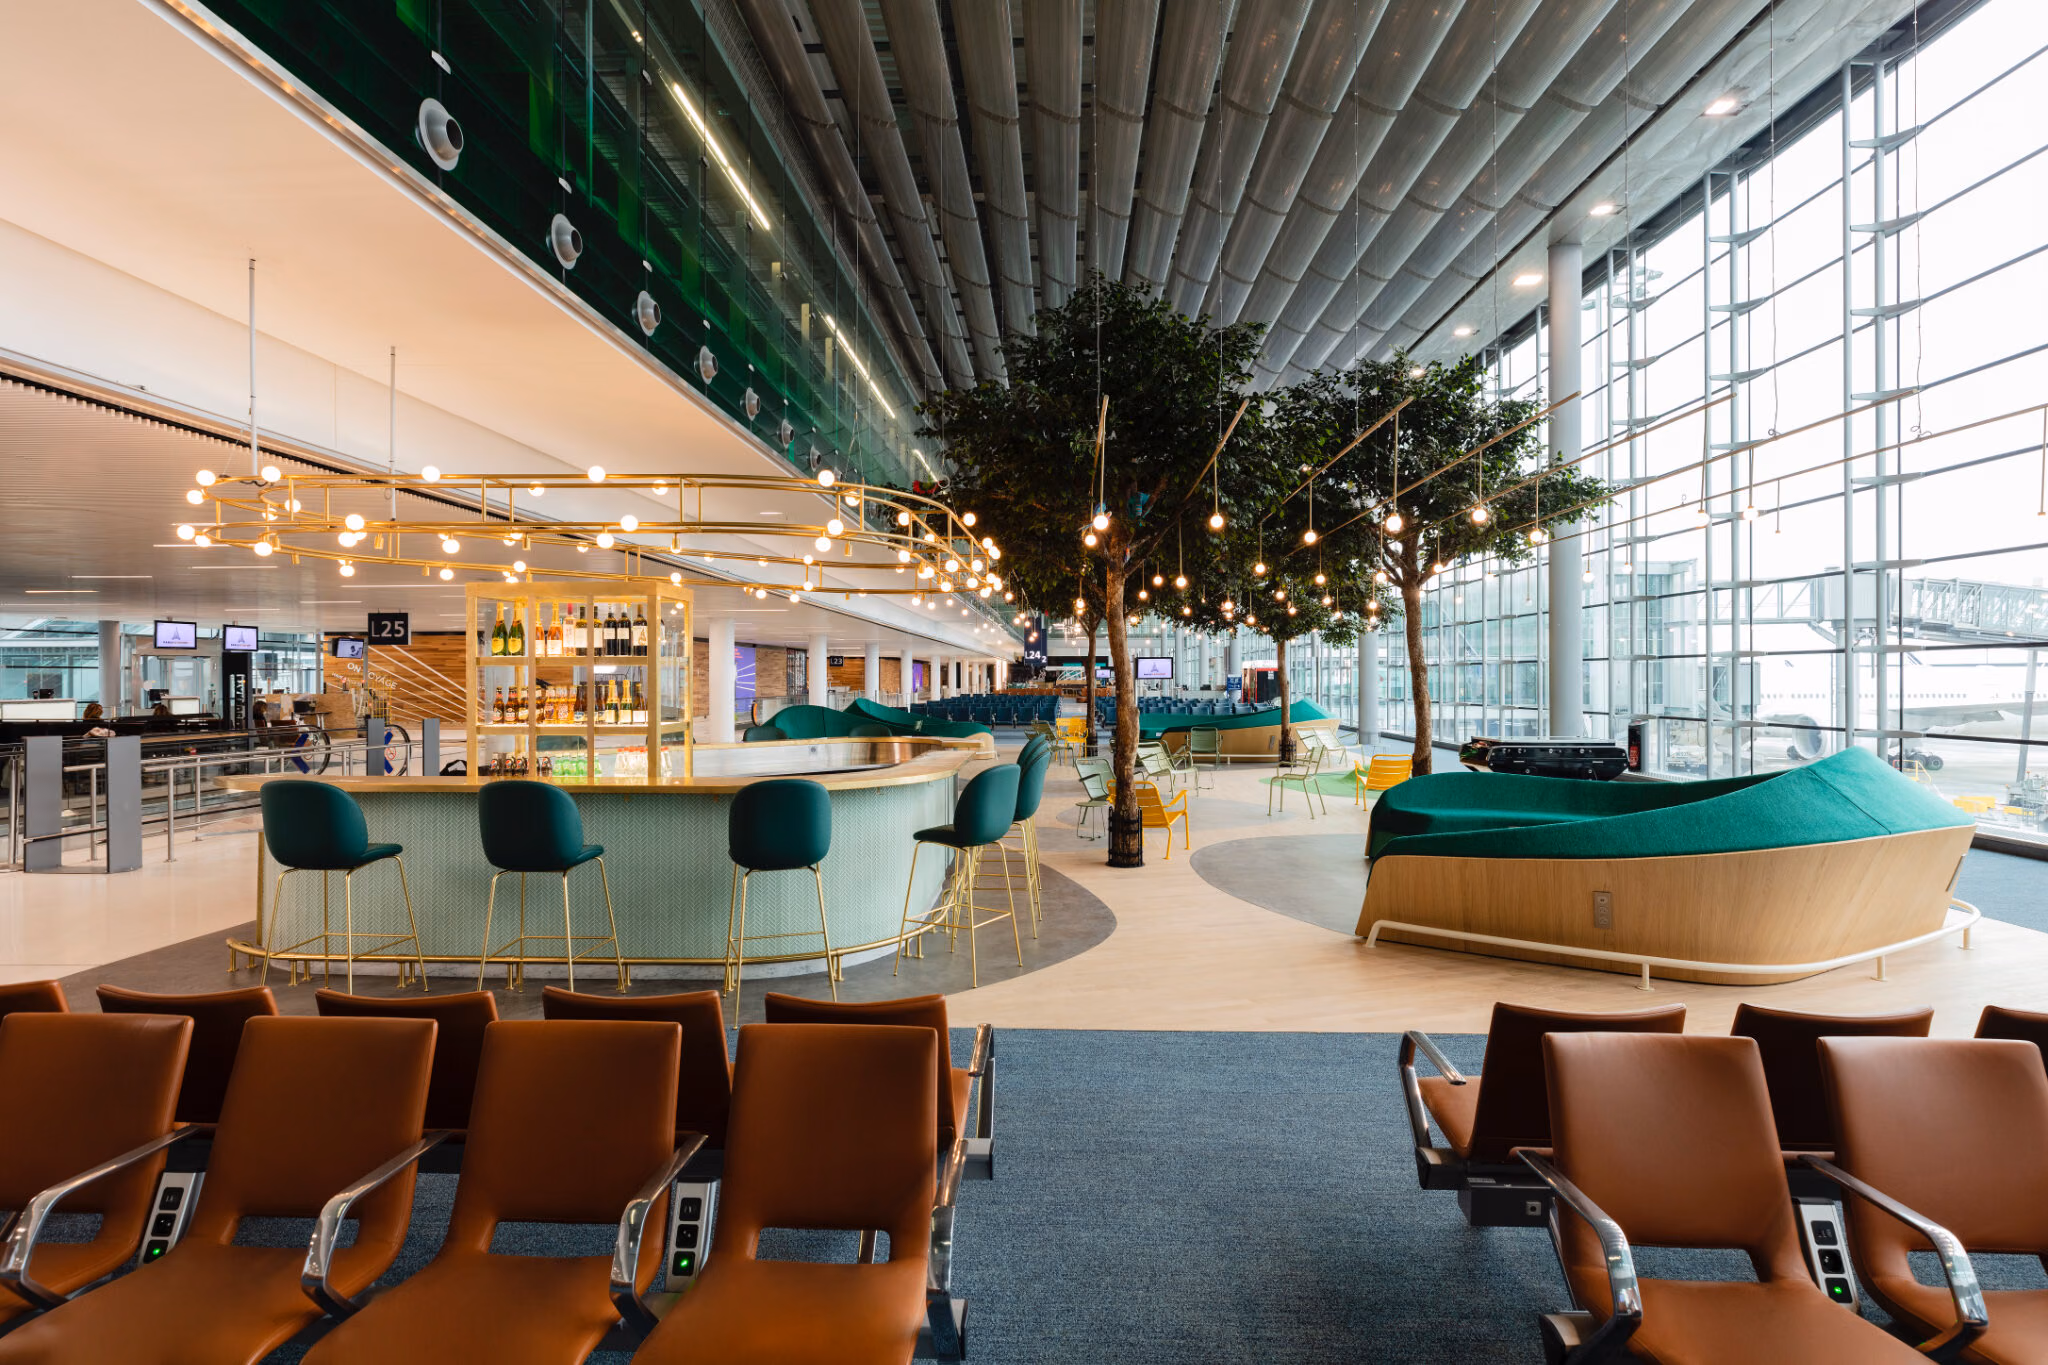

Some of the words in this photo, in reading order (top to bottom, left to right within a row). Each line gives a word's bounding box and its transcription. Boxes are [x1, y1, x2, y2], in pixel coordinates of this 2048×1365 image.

[372, 620, 405, 638] L25
[830, 657, 843, 665] L23
[1025, 651, 1041, 659] L24
[347, 662, 361, 673] ON
[367, 671, 398, 690] OYAGE
